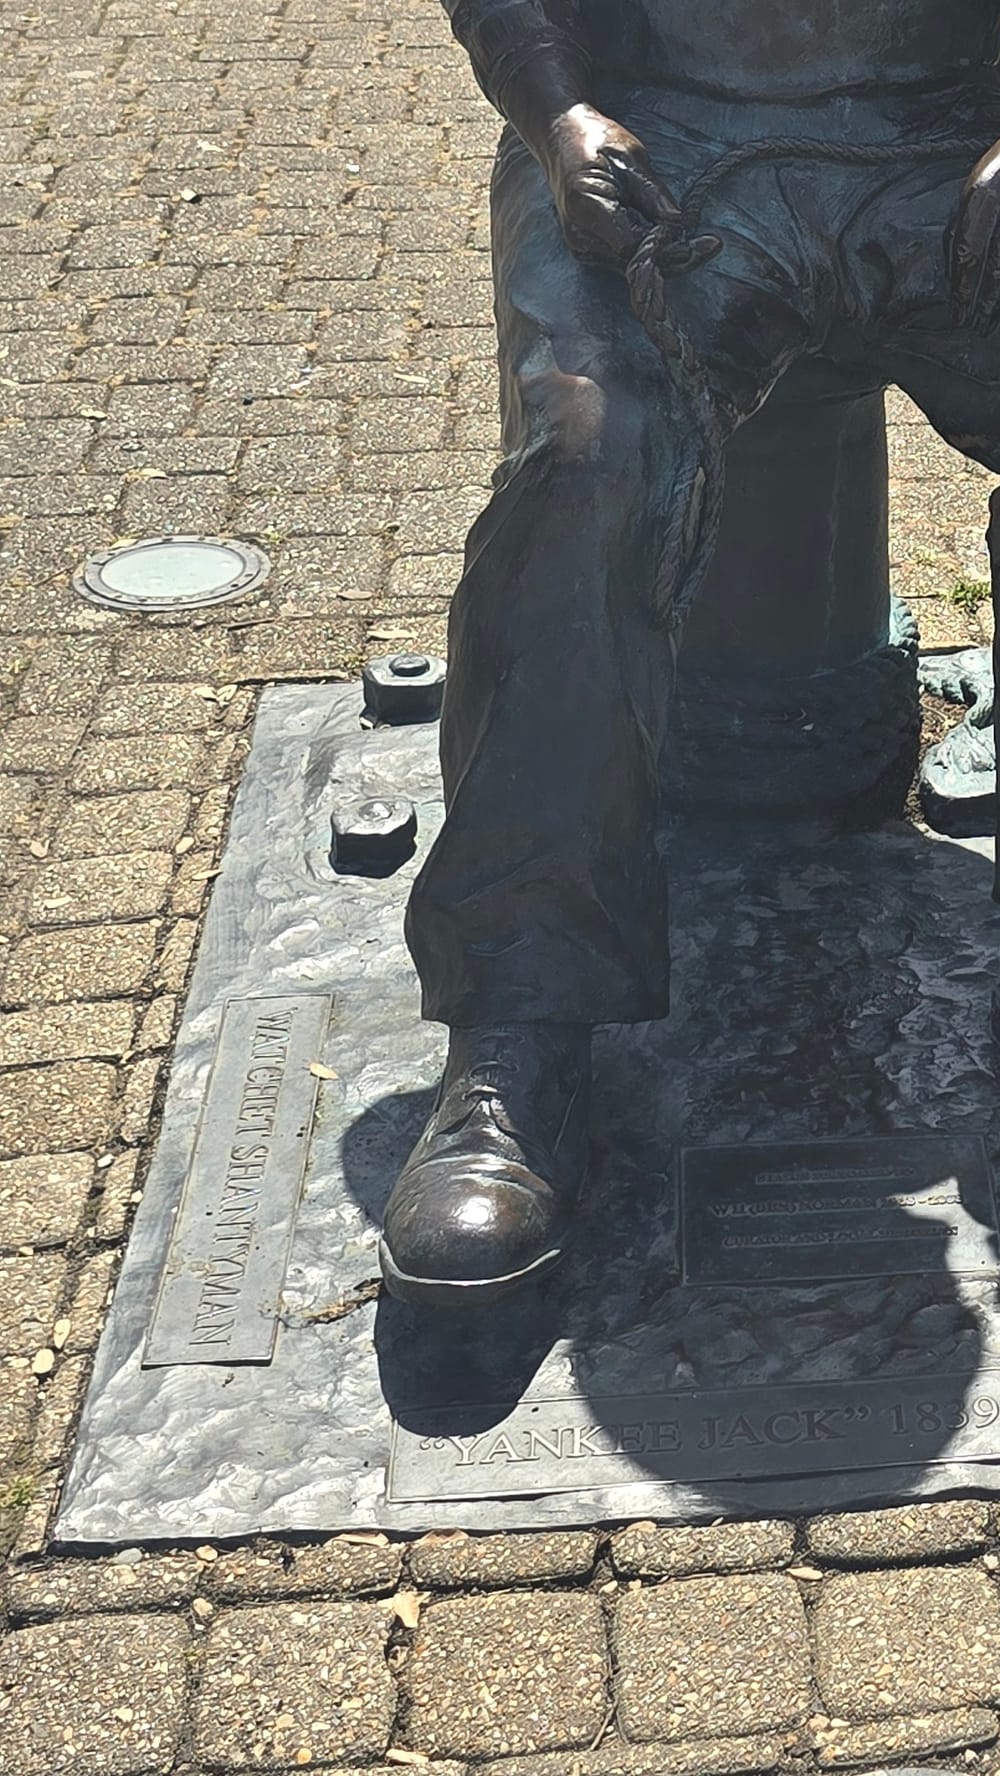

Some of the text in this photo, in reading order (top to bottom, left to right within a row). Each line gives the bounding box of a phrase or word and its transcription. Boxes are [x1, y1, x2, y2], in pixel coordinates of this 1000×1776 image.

[189, 1007, 300, 1346] WATCHET SHANTYMAN
[888, 1394, 1000, 1435] 1839
